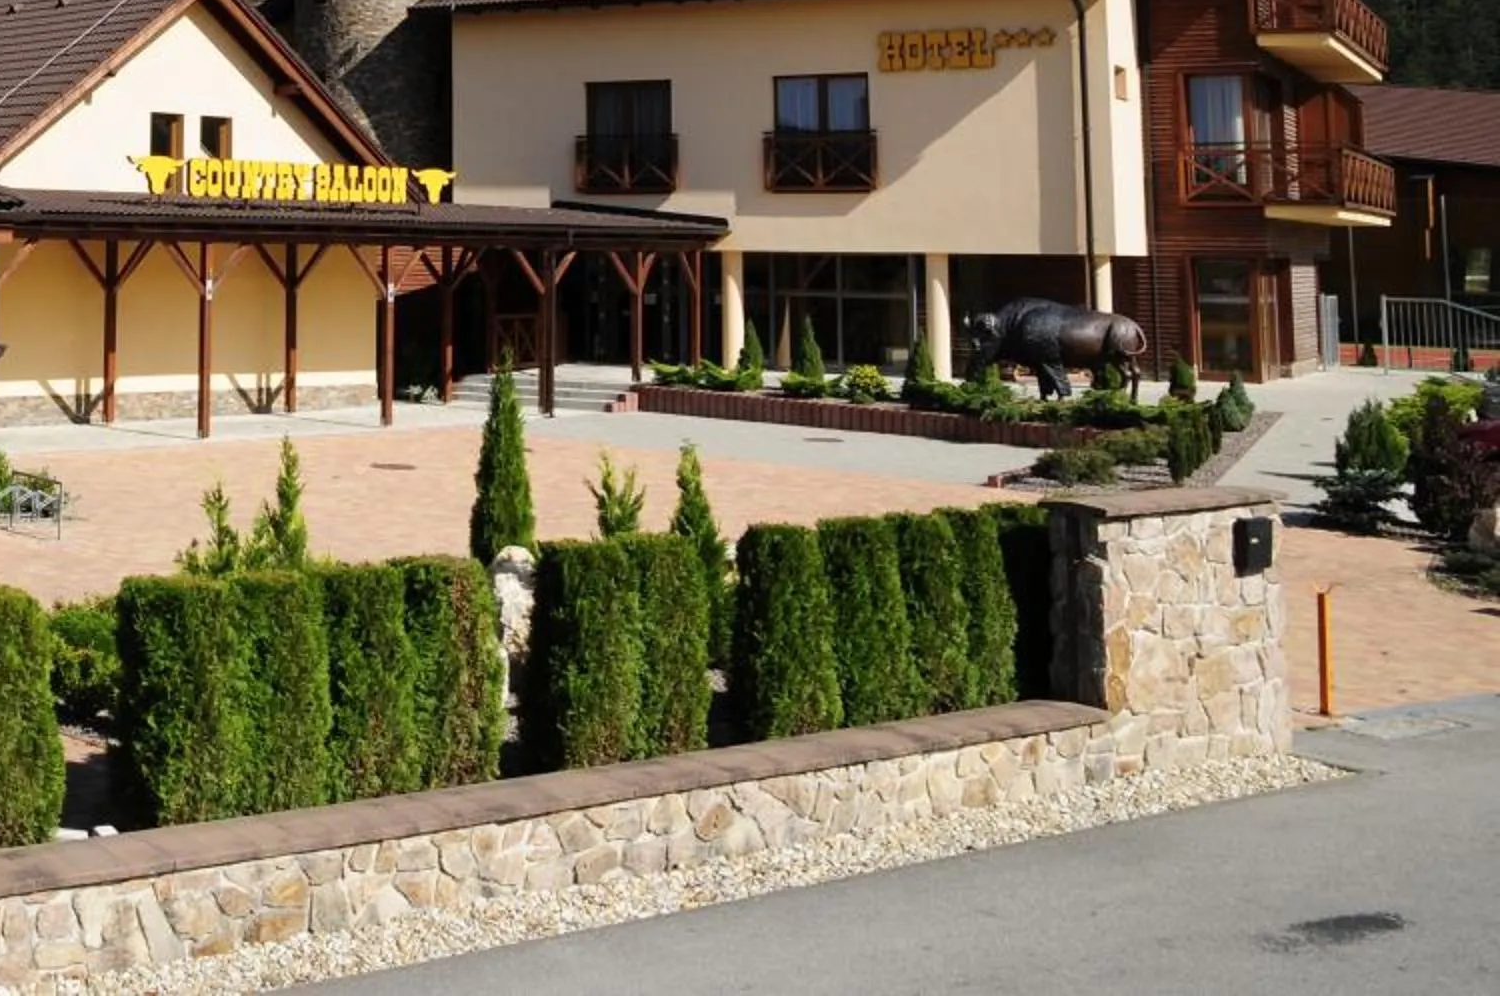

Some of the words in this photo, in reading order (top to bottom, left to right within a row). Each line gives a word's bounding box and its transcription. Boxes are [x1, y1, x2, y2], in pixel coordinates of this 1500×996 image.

[877, 28, 995, 72] HOTEL
[188, 158, 312, 200] COUNTRY
[313, 163, 408, 204] SALOON
